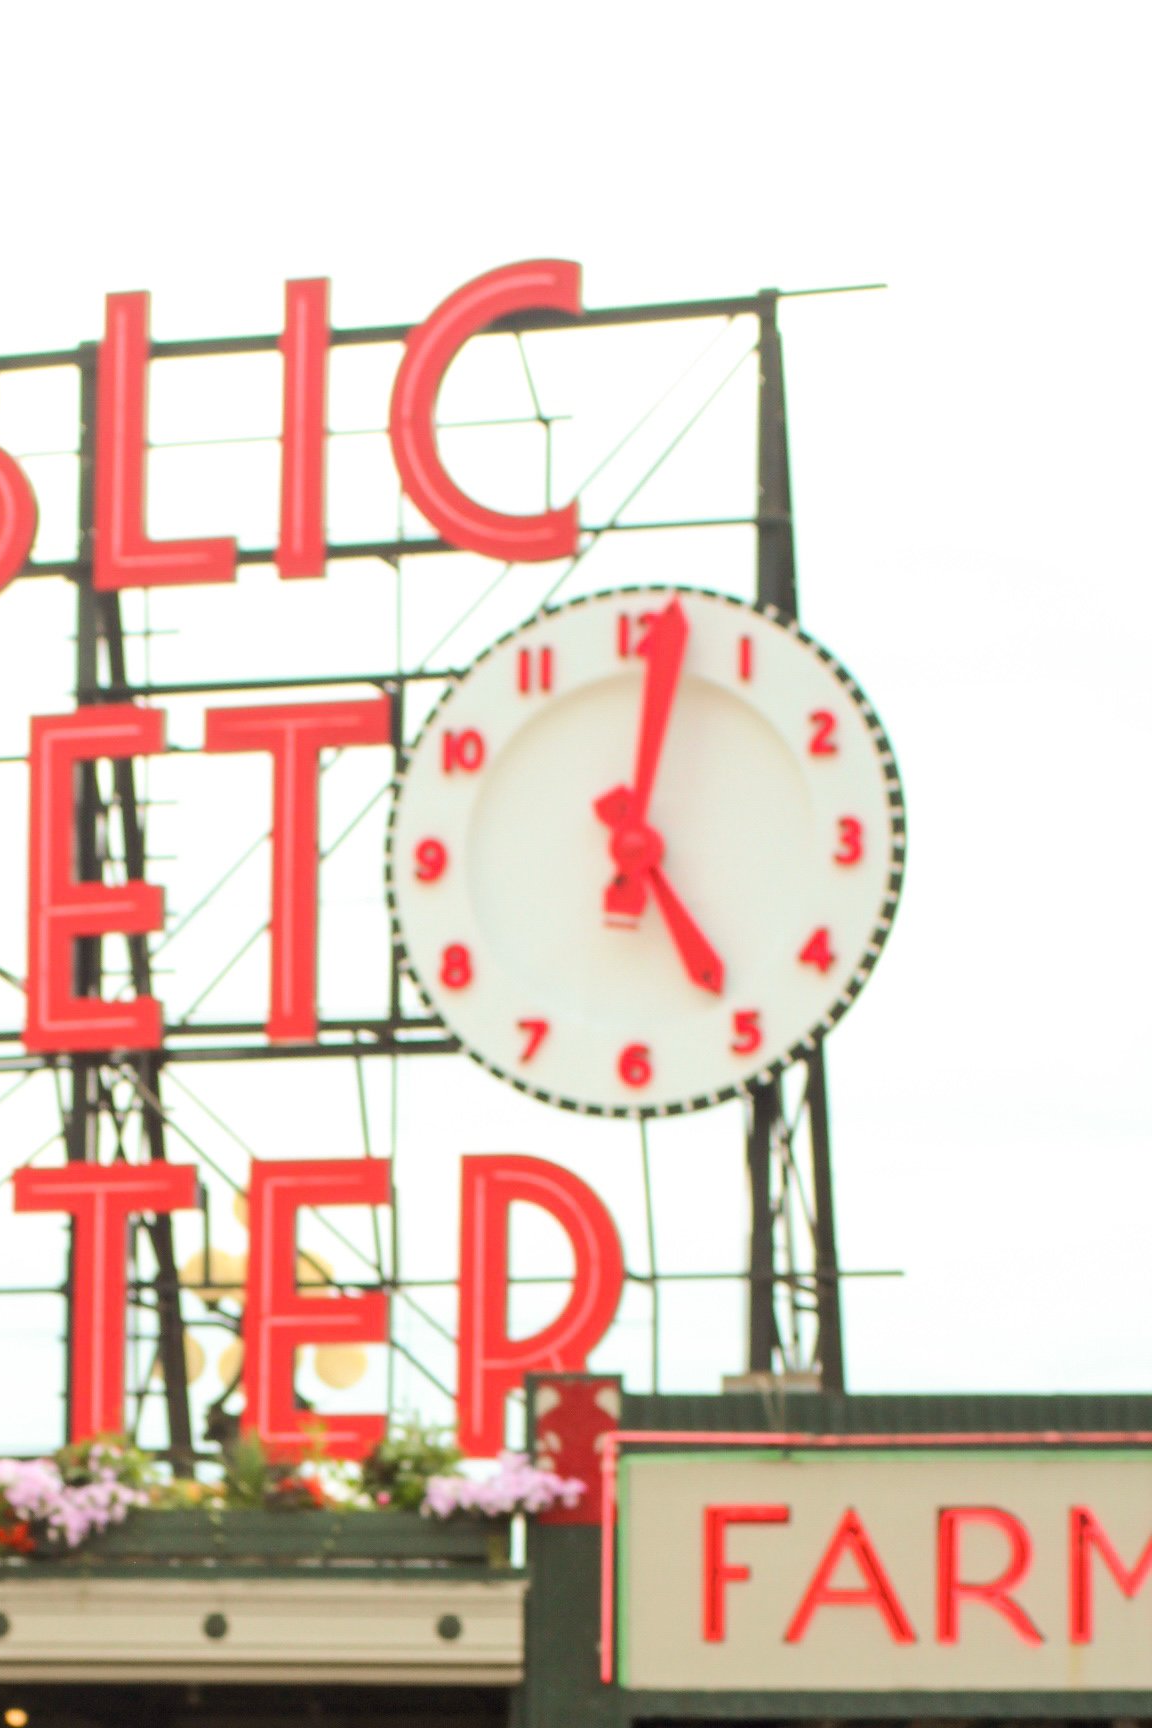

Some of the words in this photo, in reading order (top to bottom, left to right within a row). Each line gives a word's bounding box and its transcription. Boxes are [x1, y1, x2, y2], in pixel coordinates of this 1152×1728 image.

[517, 646, 554, 695] 11
[738, 635, 753, 683] 1
[440, 728, 486, 776] 10
[808, 709, 838, 757] 2
[413, 838, 449, 884] 9
[833, 816, 865, 867] 3
[438, 943, 474, 991] 8
[798, 927, 837, 975] 4
[516, 1019, 550, 1064] 7
[729, 1009, 764, 1058] 5
[616, 1042, 653, 1088] 6
[704, 1504, 1152, 1647] FARM
